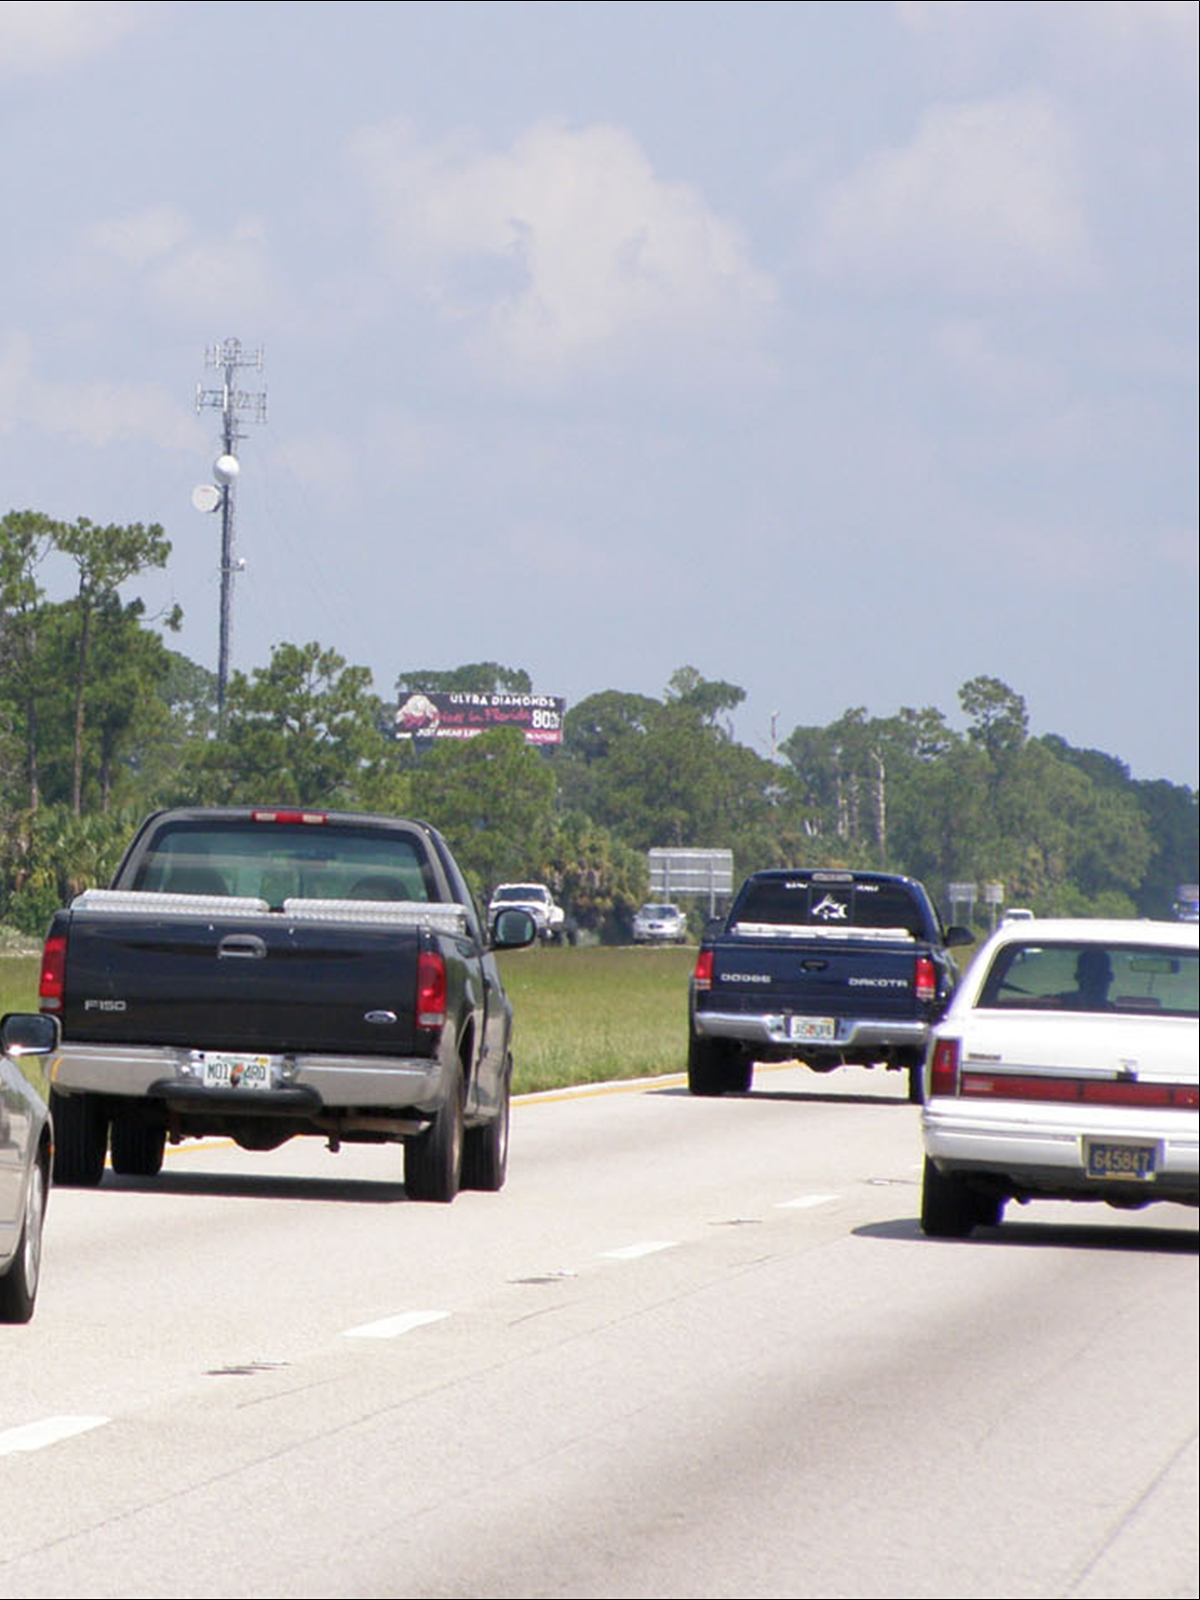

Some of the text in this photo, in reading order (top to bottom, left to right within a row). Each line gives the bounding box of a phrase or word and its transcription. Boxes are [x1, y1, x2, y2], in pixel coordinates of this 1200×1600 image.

[450, 694, 556, 708] ULTRA DIAMONDS
[720, 973, 772, 984] DODGE
[848, 976, 908, 988] DAKOTA
[84, 1000, 127, 1011] F150
